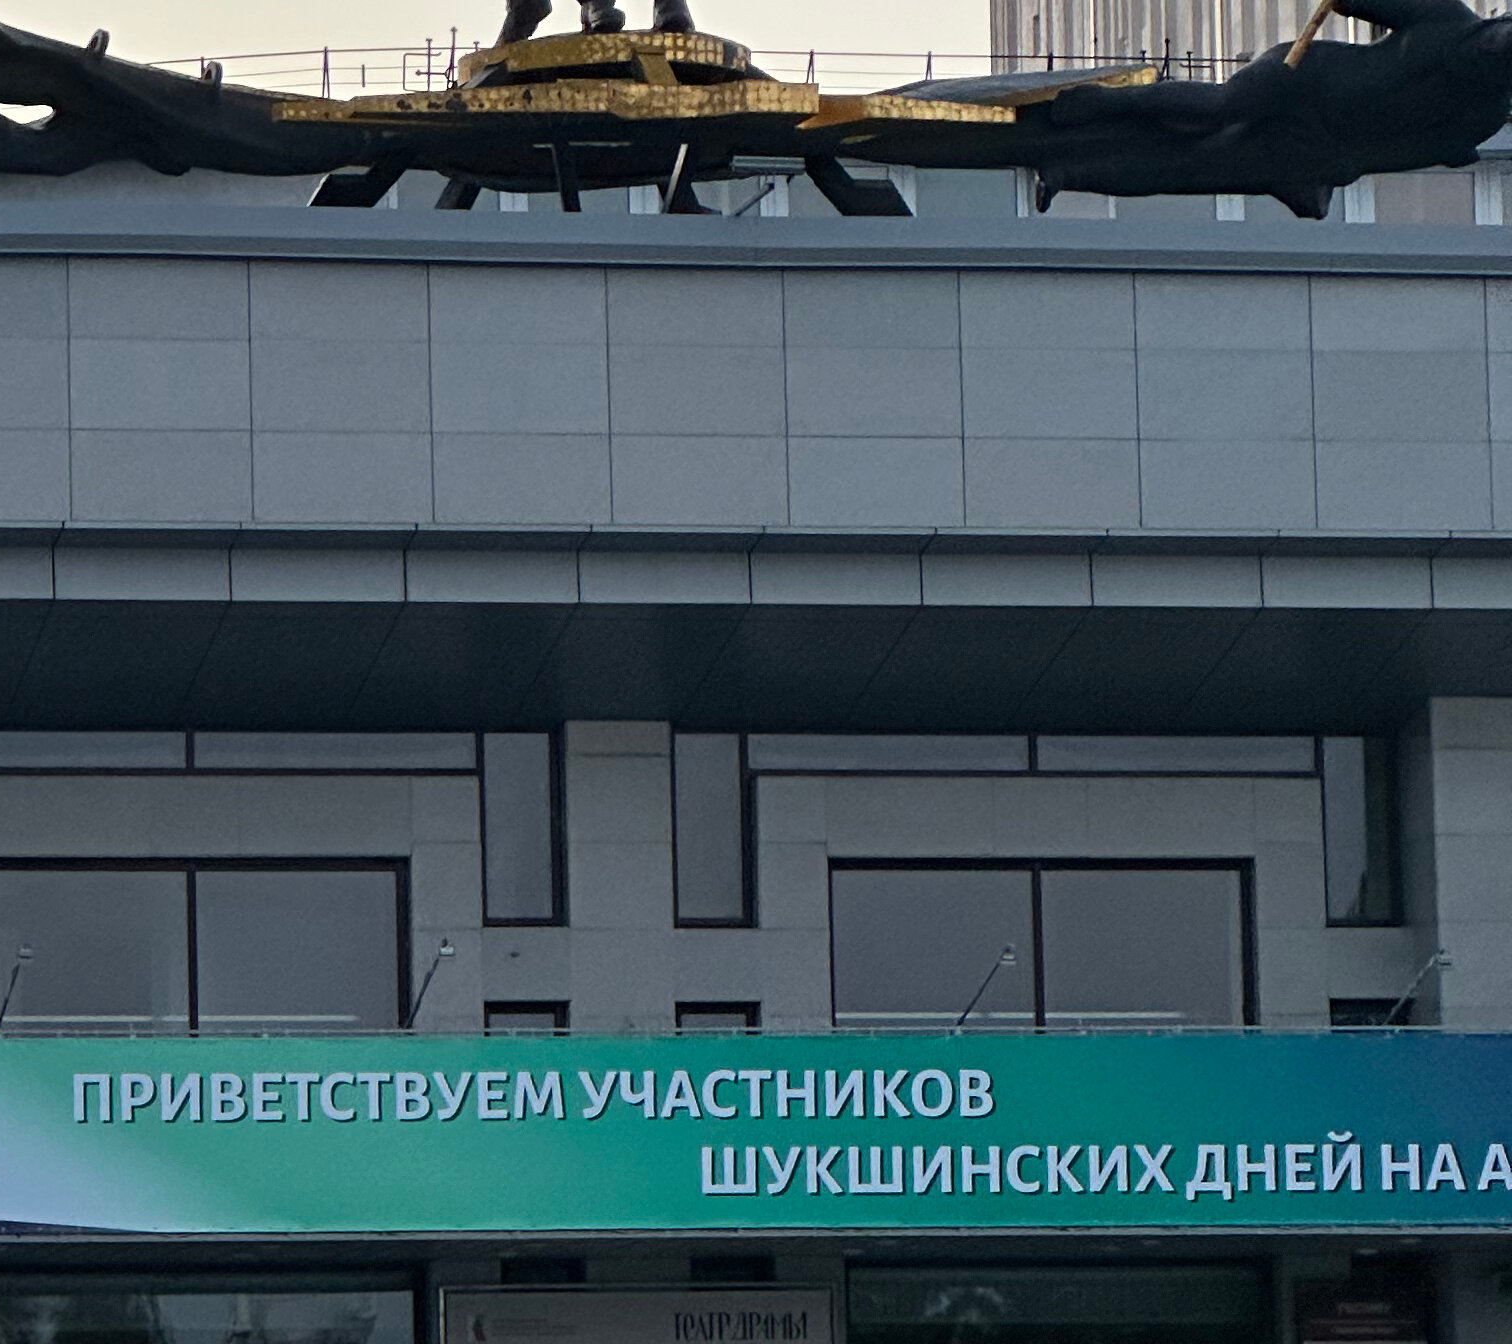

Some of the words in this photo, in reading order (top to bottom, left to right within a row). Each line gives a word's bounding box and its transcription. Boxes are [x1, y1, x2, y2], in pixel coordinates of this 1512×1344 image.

[72, 1069, 565, 1123] ПРИВЕТСТВУЕМ
[577, 1067, 994, 1120] УЧАСТНИКОВ
[700, 1142, 1175, 1197] ШУКШИНСКИХ
[1184, 1130, 1364, 1201] ДНЕЙ
[1380, 1142, 1467, 1192] НА
